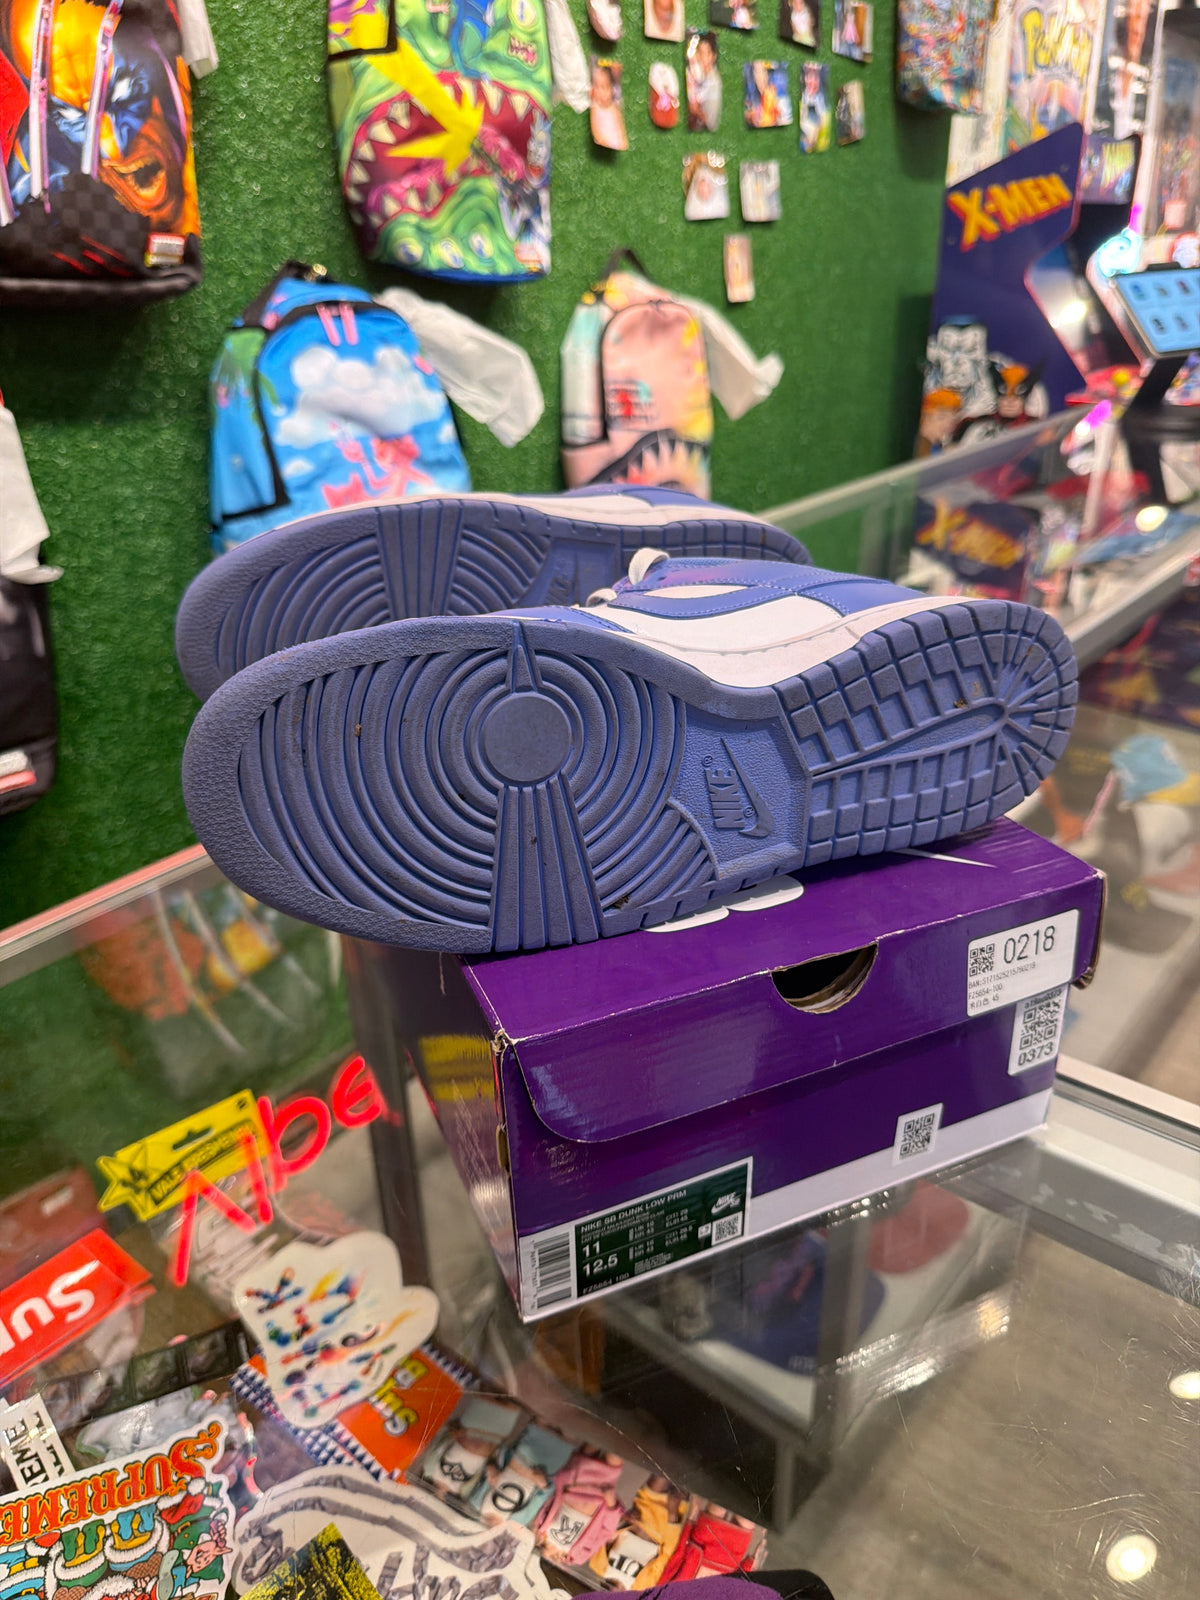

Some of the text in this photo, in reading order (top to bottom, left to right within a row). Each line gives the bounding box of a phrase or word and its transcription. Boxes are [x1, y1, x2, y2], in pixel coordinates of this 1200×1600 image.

[946, 172, 1072, 253] X-MEN
[703, 768, 746, 829] NIKE
[1003, 925, 1056, 964] 0218
[1018, 1042, 1053, 1067] 0373
[581, 1219, 602, 1234] NIKE
[618, 1205, 644, 1220] DUNK
[646, 1197, 666, 1211] LOW
[667, 1189, 687, 1202] PRM
[582, 1240, 601, 1258] 11
[582, 1252, 619, 1278] 12.5
[2, 1417, 50, 1488] EME
[0, 1421, 222, 1546] SUPREME
